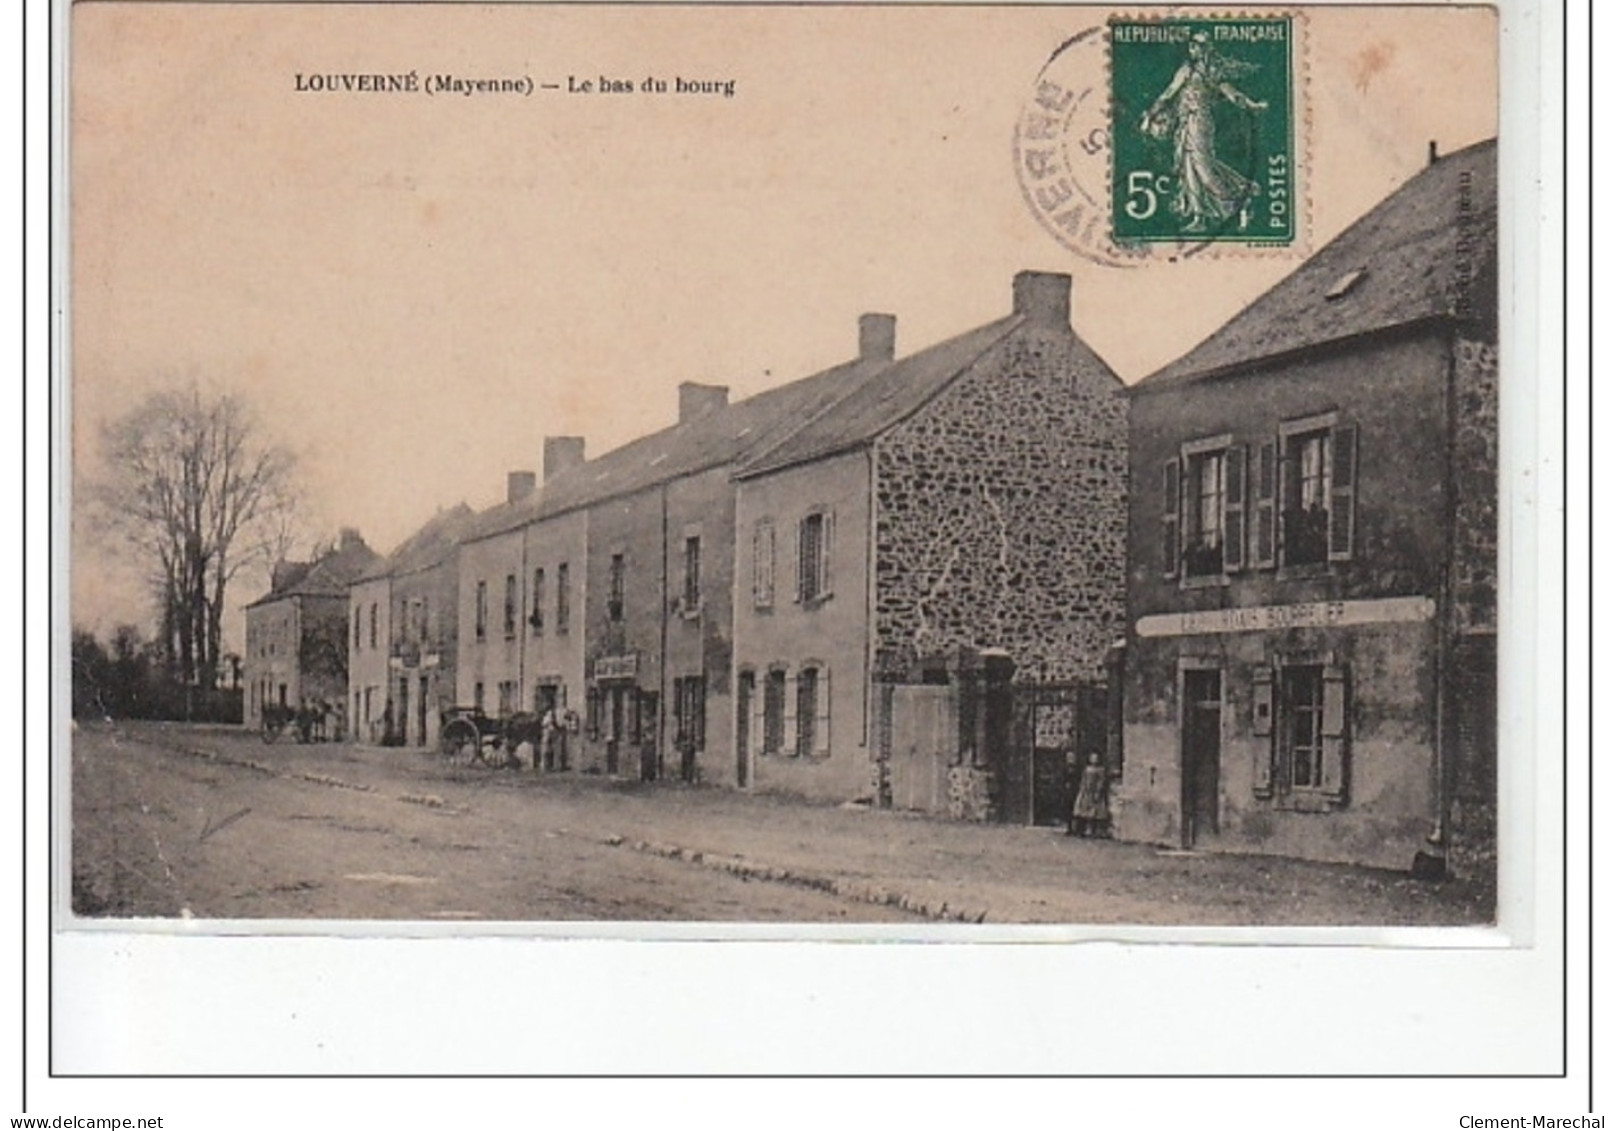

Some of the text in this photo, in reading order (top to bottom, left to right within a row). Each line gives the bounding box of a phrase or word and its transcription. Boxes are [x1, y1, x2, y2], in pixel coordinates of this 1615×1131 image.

[1214, 25, 1285, 42] FRANÇAISE
[294, 71, 419, 92] LOUVERNÉ
[425, 75, 534, 97] (Mayenne)
[568, 77, 593, 94] Le
[599, 77, 634, 94] bas
[641, 77, 667, 94] du
[676, 77, 736, 98] bourg
[1268, 154, 1286, 228] POSTES
